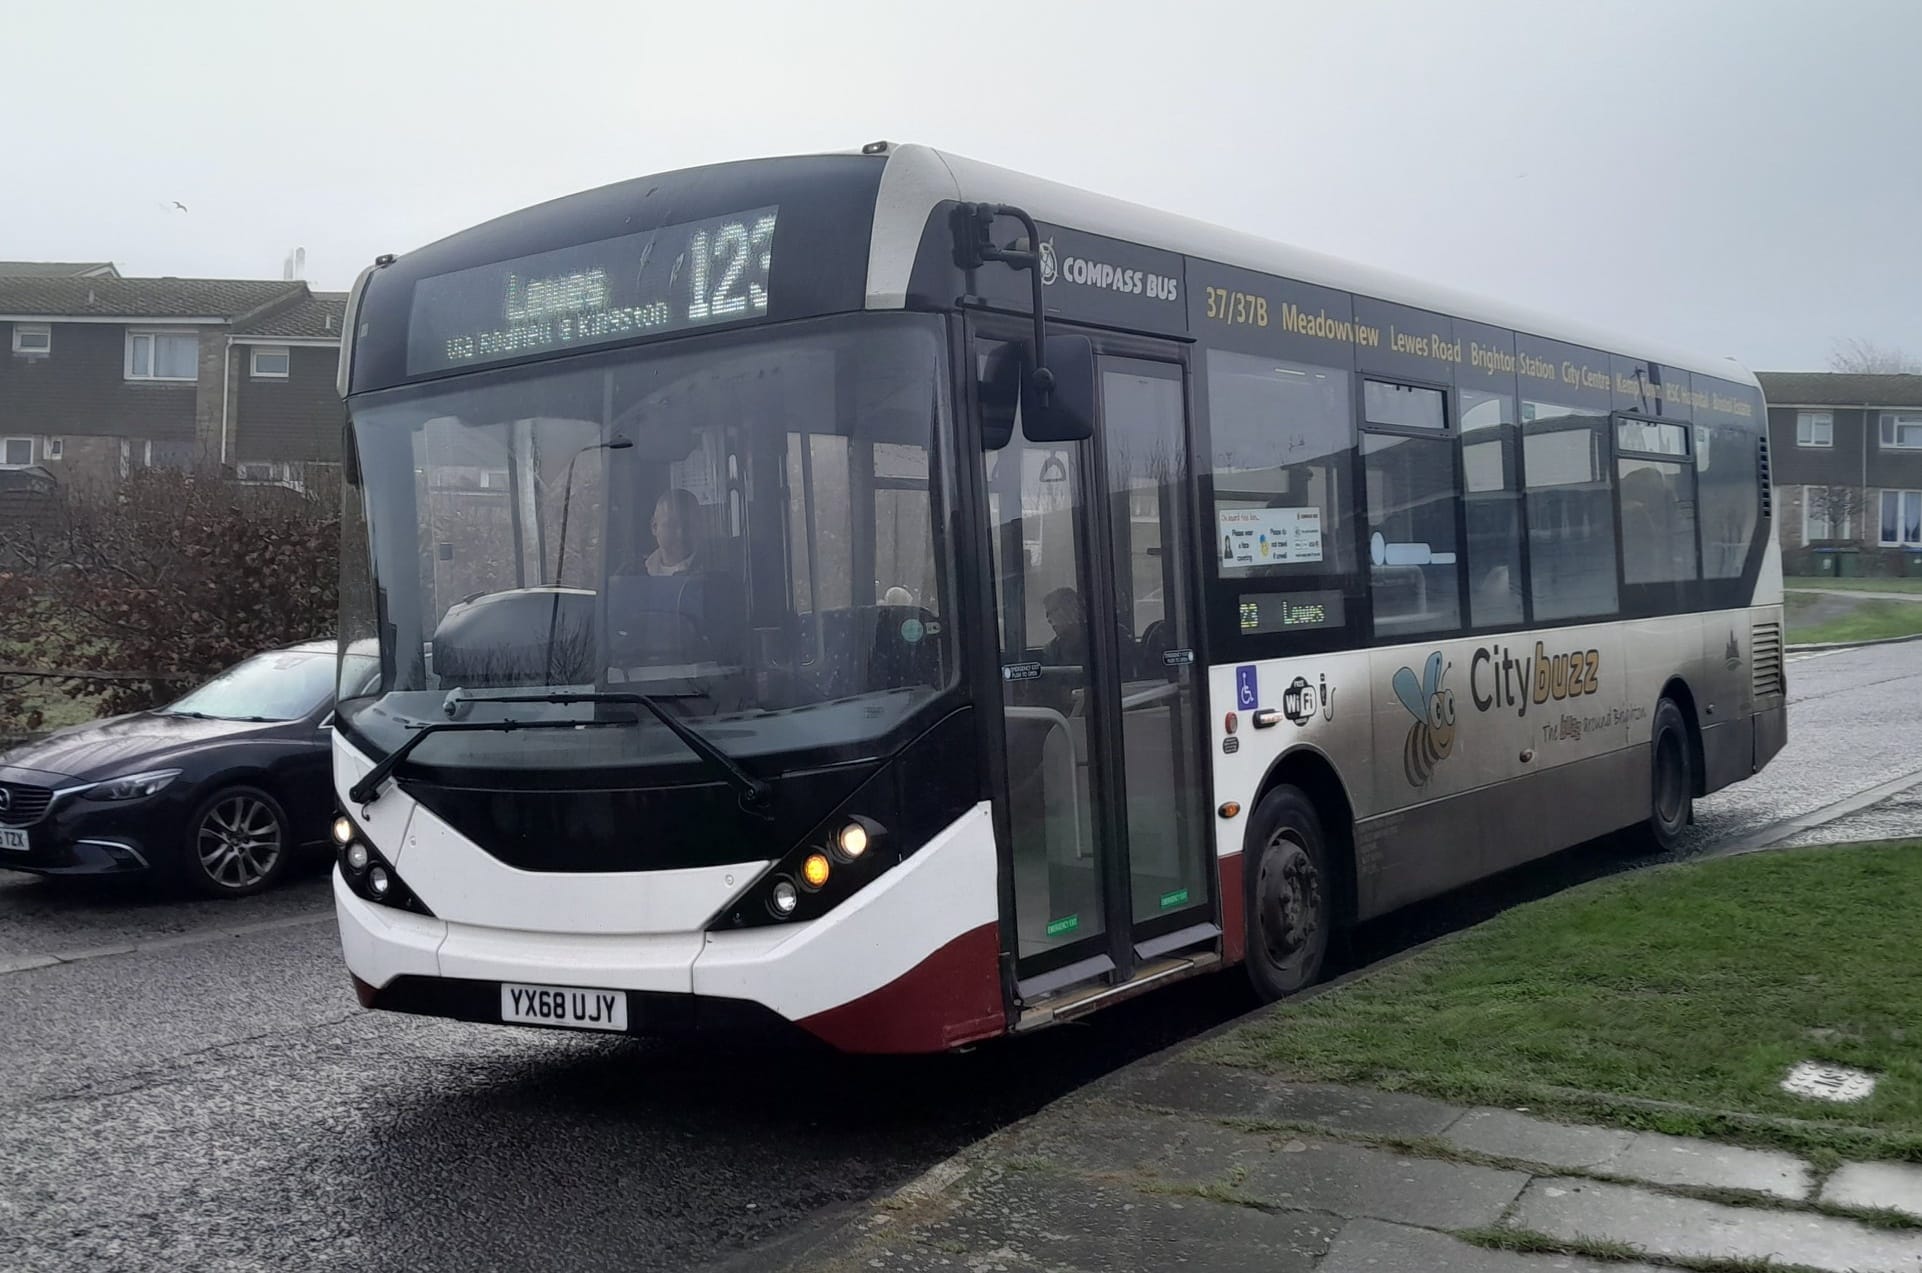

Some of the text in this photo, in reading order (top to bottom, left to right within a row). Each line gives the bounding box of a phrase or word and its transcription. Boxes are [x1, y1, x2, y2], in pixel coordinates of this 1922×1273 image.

[1062, 256, 1178, 301] COMPASS BUS
[1206, 286, 1268, 327] 37/37B
[1282, 302, 1379, 348] Meadowview
[1390, 324, 1429, 357] Lewes
[1431, 333, 1462, 363] Road
[1519, 352, 1556, 380] Station
[1562, 360, 1581, 390] City
[1582, 365, 1611, 390] Centre
[4, 831, 25, 847] TZX
[510, 988, 616, 1023] YX68 UJY
